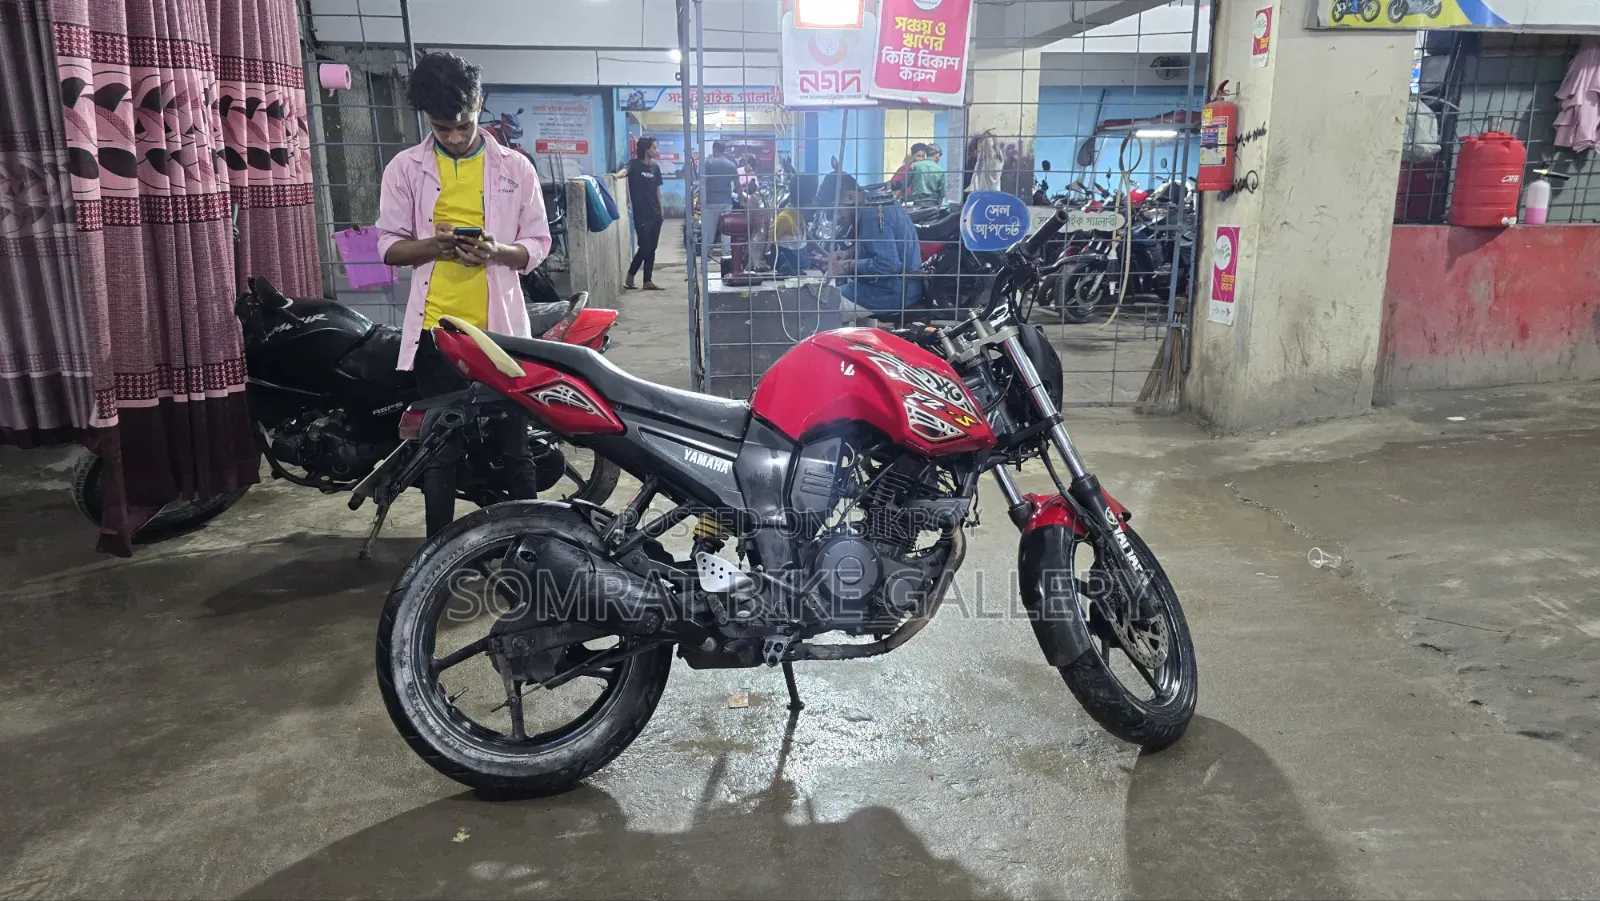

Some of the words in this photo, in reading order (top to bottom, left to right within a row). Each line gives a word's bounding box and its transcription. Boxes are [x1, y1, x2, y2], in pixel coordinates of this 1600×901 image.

[895, 16, 933, 34] সঞ্চয়
[935, 22, 947, 35] ও
[902, 33, 946, 51] ঋণের
[881, 46, 915, 64] কিস্তি
[917, 50, 960, 71] বিকাশ
[799, 69, 861, 93] নগদ
[899, 67, 936, 83] করুন
[985, 204, 1010, 221] সেল
[973, 216, 1020, 241] আপডেট
[683, 447, 730, 475] YAMAHA
